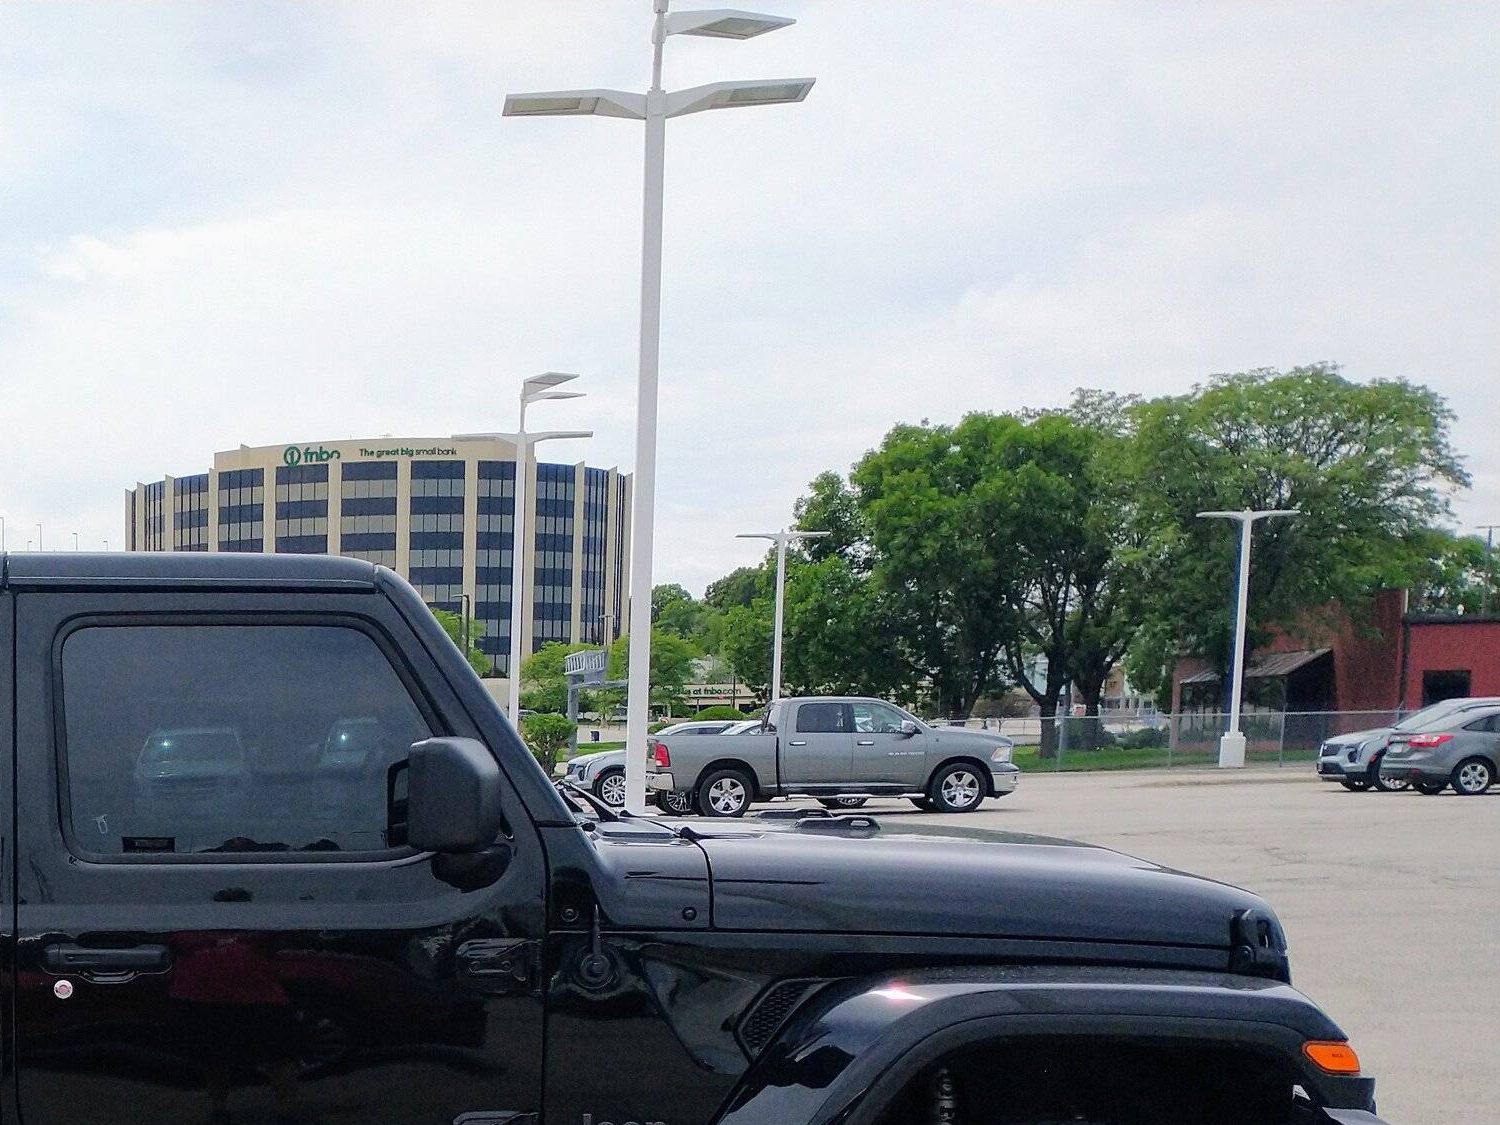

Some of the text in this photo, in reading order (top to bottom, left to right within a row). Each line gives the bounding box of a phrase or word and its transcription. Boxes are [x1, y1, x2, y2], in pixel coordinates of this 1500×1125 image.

[303, 446, 341, 463] fnbo
[359, 447, 457, 458] The great big small bank
[692, 687, 702, 695] at
